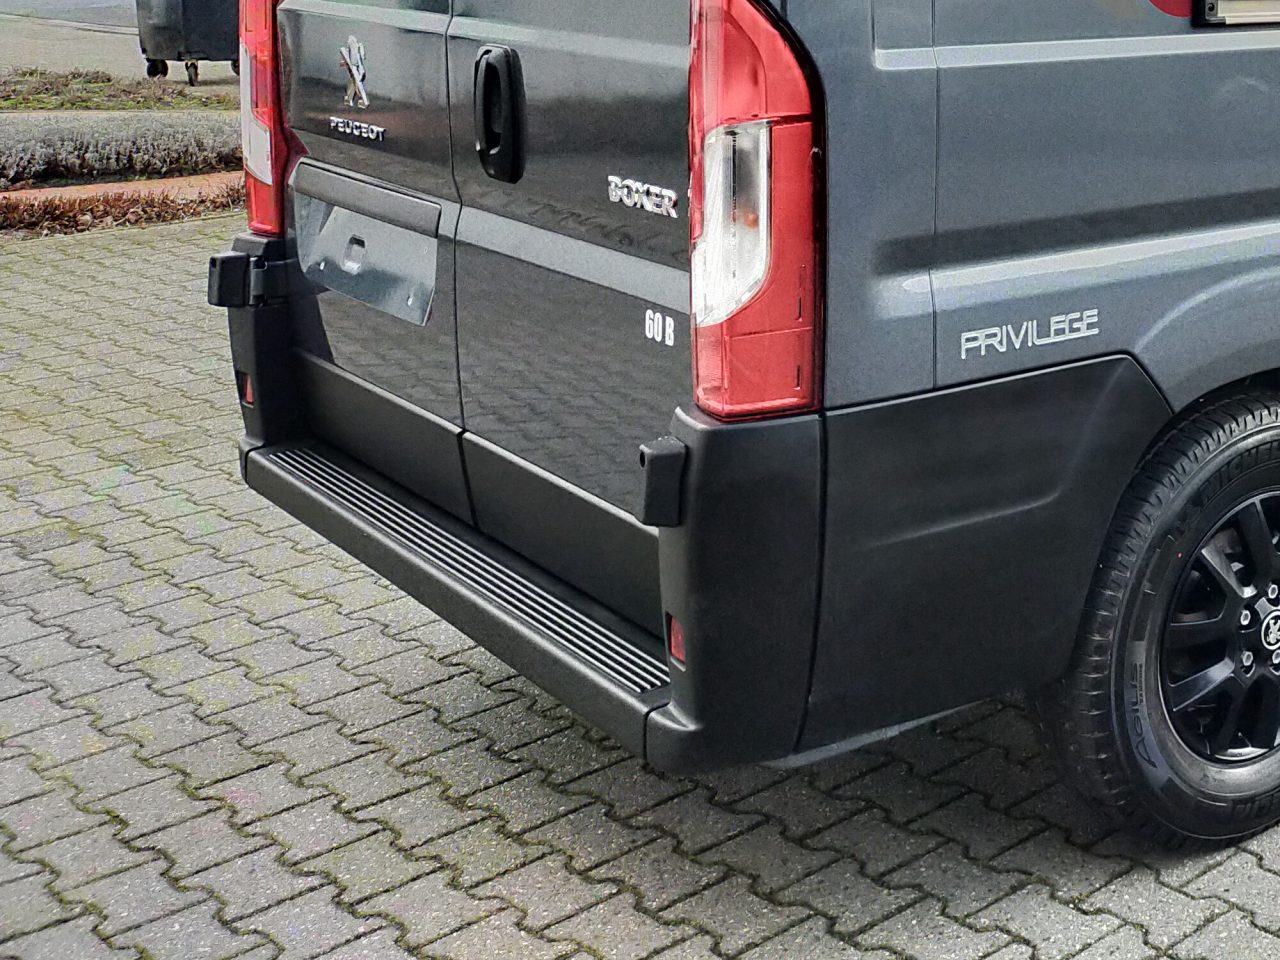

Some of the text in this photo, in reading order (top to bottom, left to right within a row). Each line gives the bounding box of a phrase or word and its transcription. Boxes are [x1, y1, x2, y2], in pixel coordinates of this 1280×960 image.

[329, 116, 386, 142] PEUGEOT
[607, 175, 679, 218] BOXER
[645, 309, 675, 346] 60 B
[961, 308, 1099, 359] PRIVILEGE
